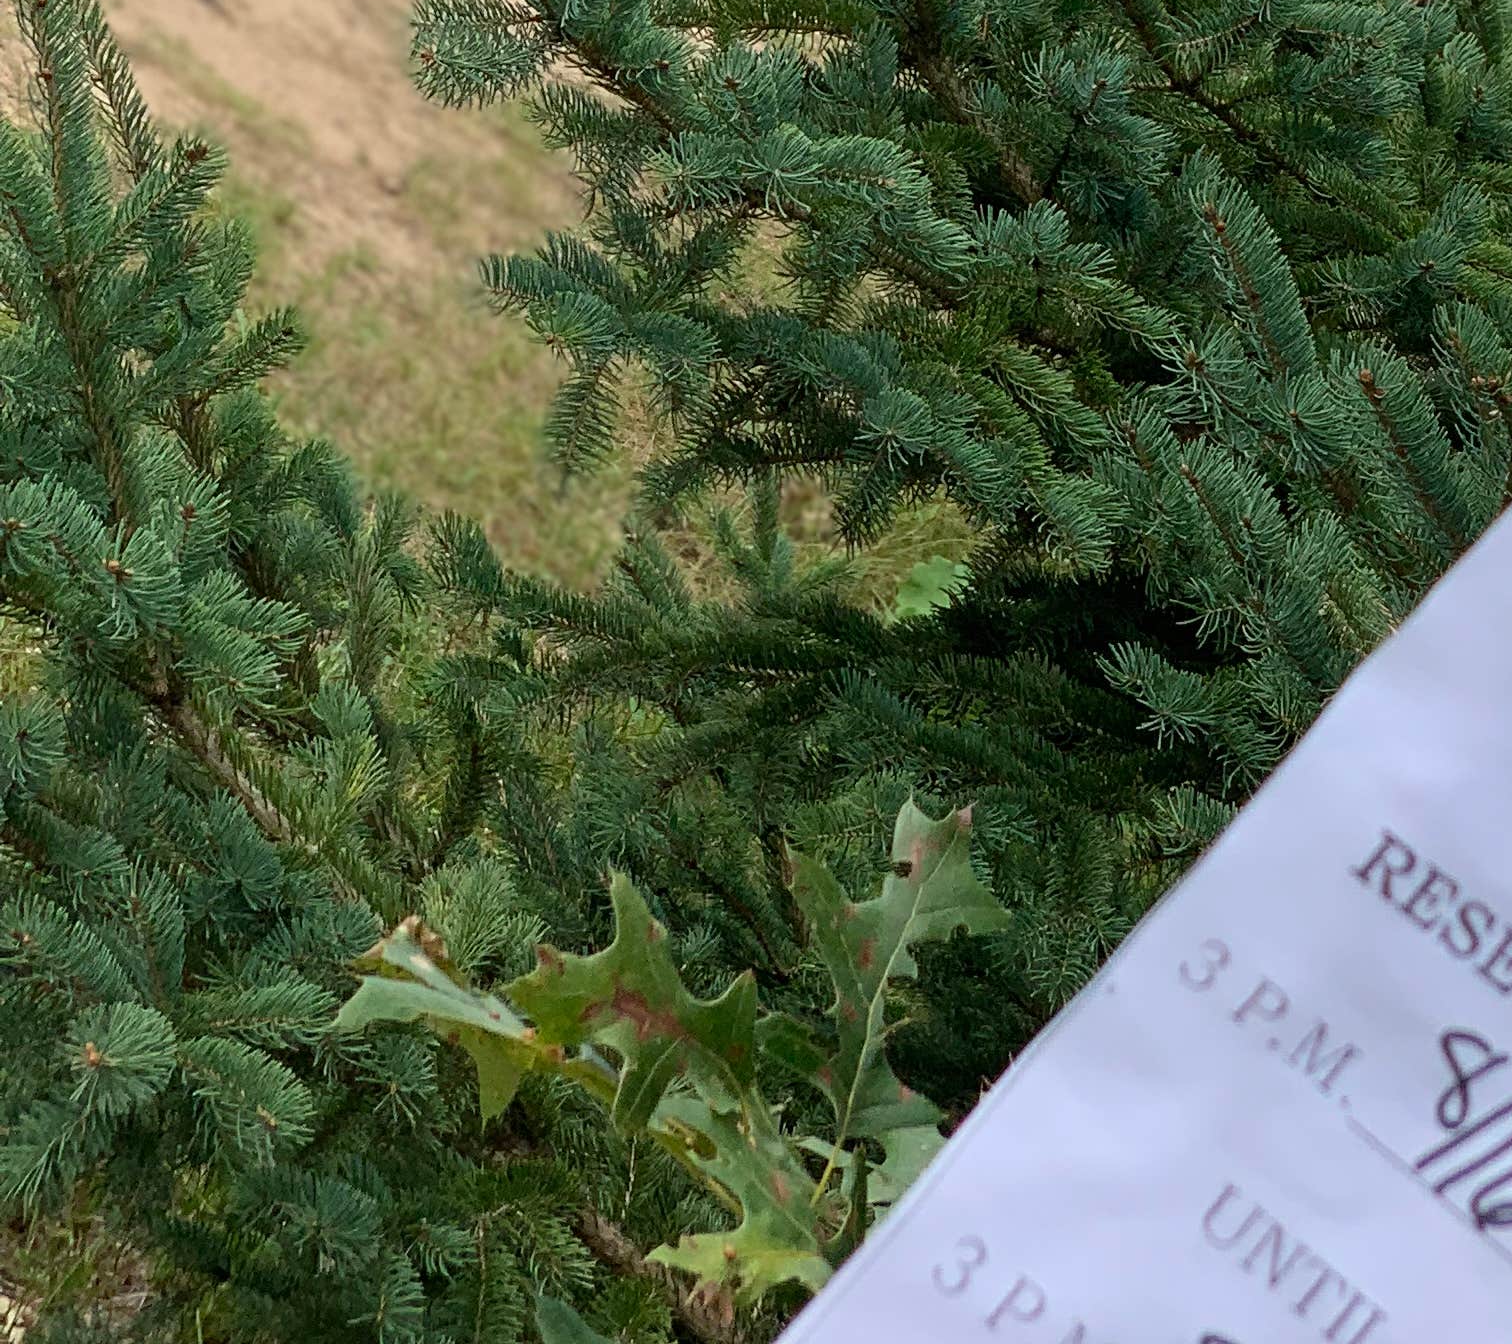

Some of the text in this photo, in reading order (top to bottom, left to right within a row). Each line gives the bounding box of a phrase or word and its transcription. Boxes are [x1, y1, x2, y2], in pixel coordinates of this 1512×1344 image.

[1178, 938, 1231, 991] 3
[1232, 977, 1363, 1109] P.M.
[932, 1234, 987, 1297] 3
